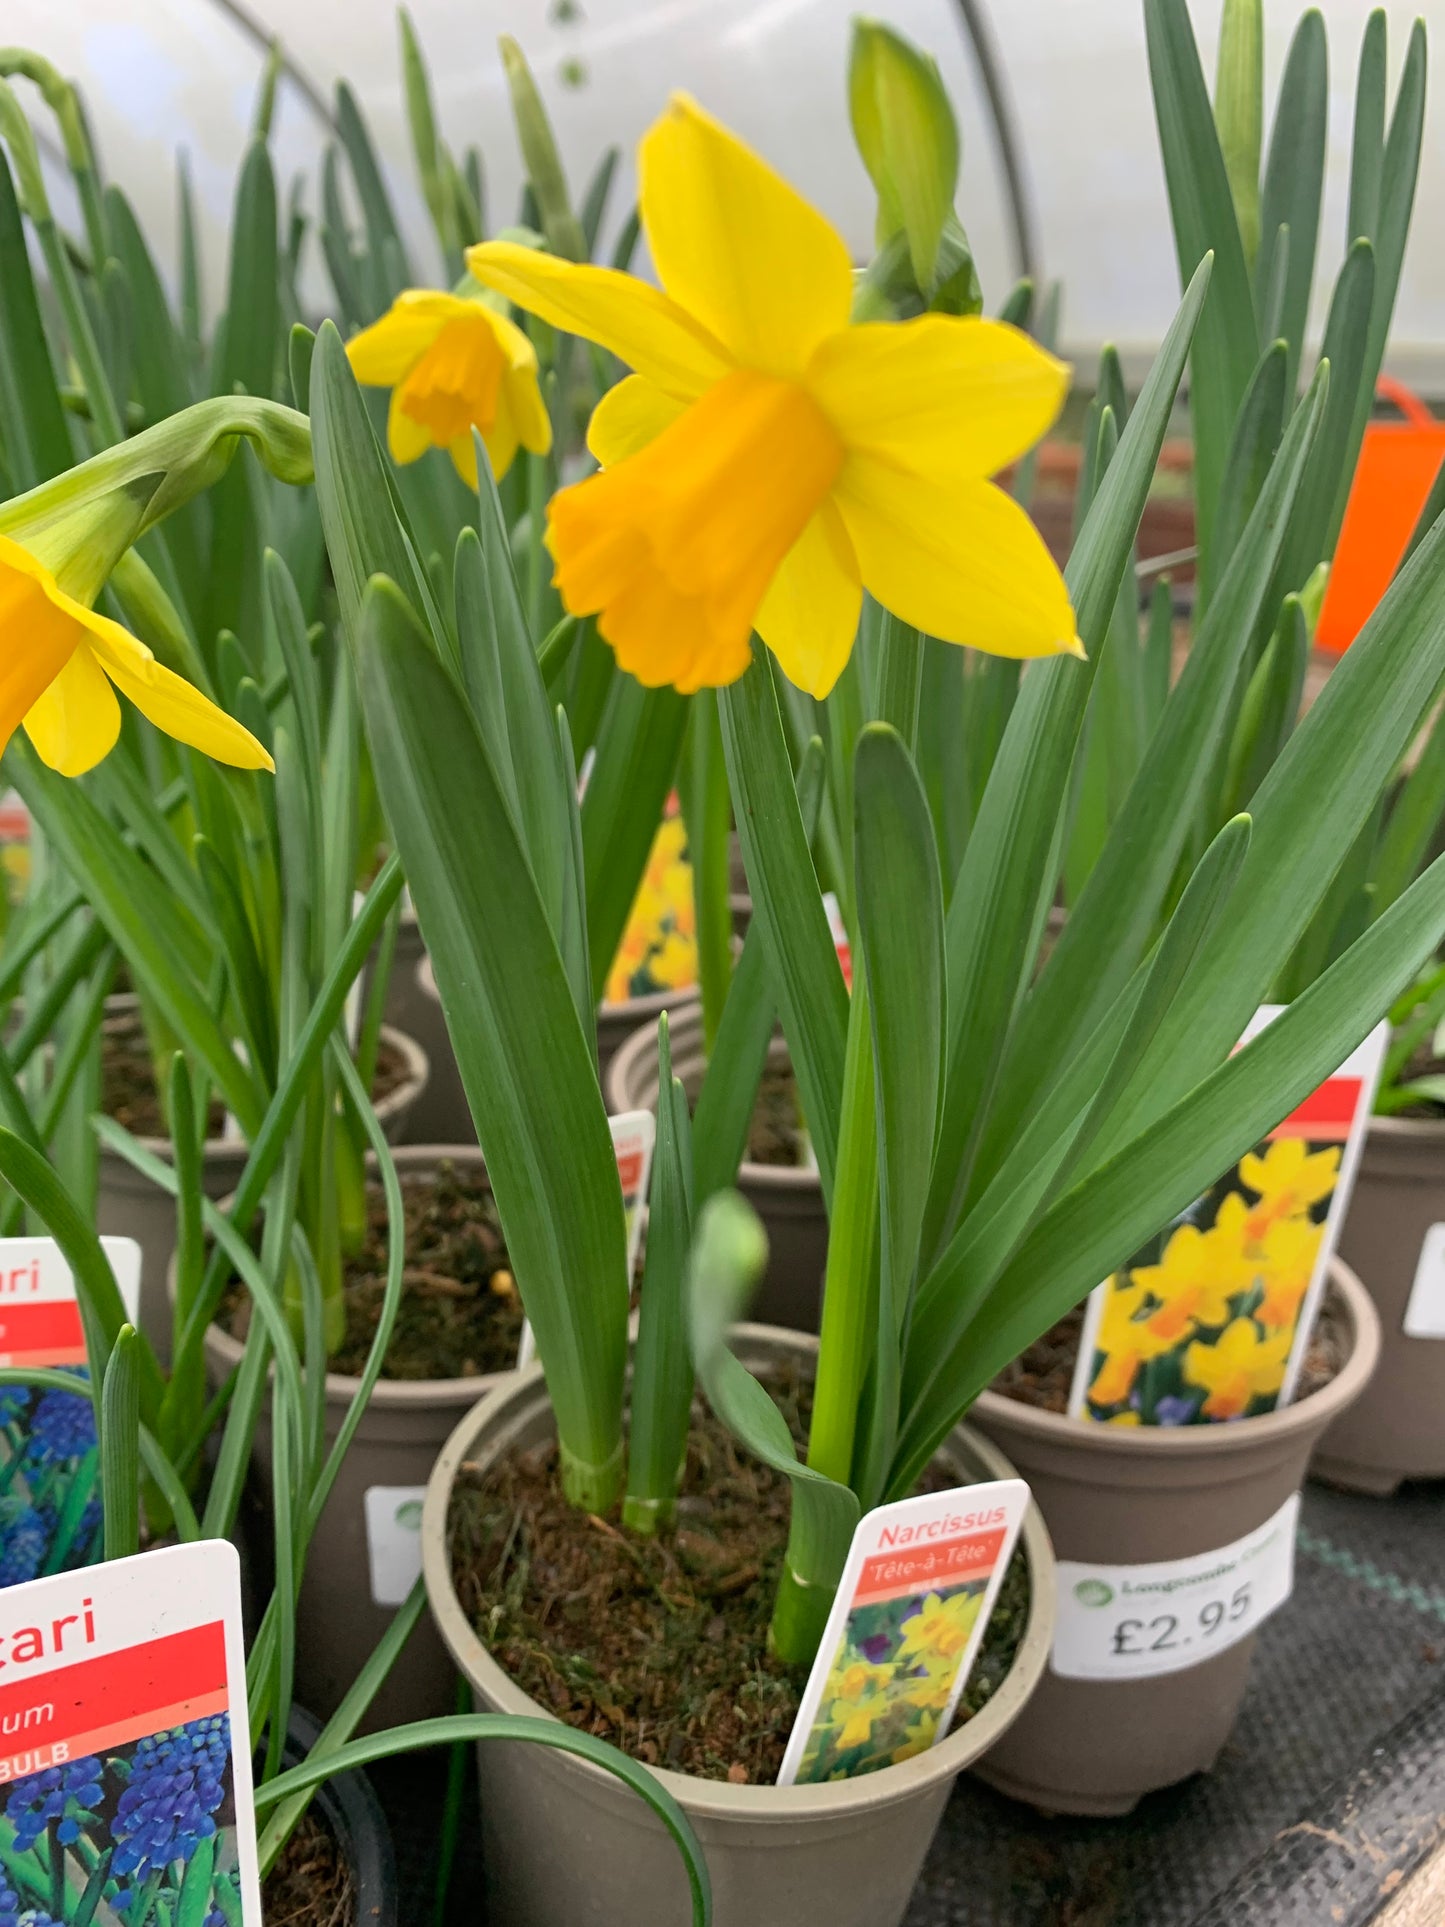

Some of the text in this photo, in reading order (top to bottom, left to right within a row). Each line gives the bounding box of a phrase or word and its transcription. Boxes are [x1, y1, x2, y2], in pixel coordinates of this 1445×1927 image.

[0, 1259, 39, 1293] ri
[877, 1506, 1006, 1548] Narcissus
[0, 1598, 95, 1669] ari
[1110, 1580, 1252, 1655] £2.95
